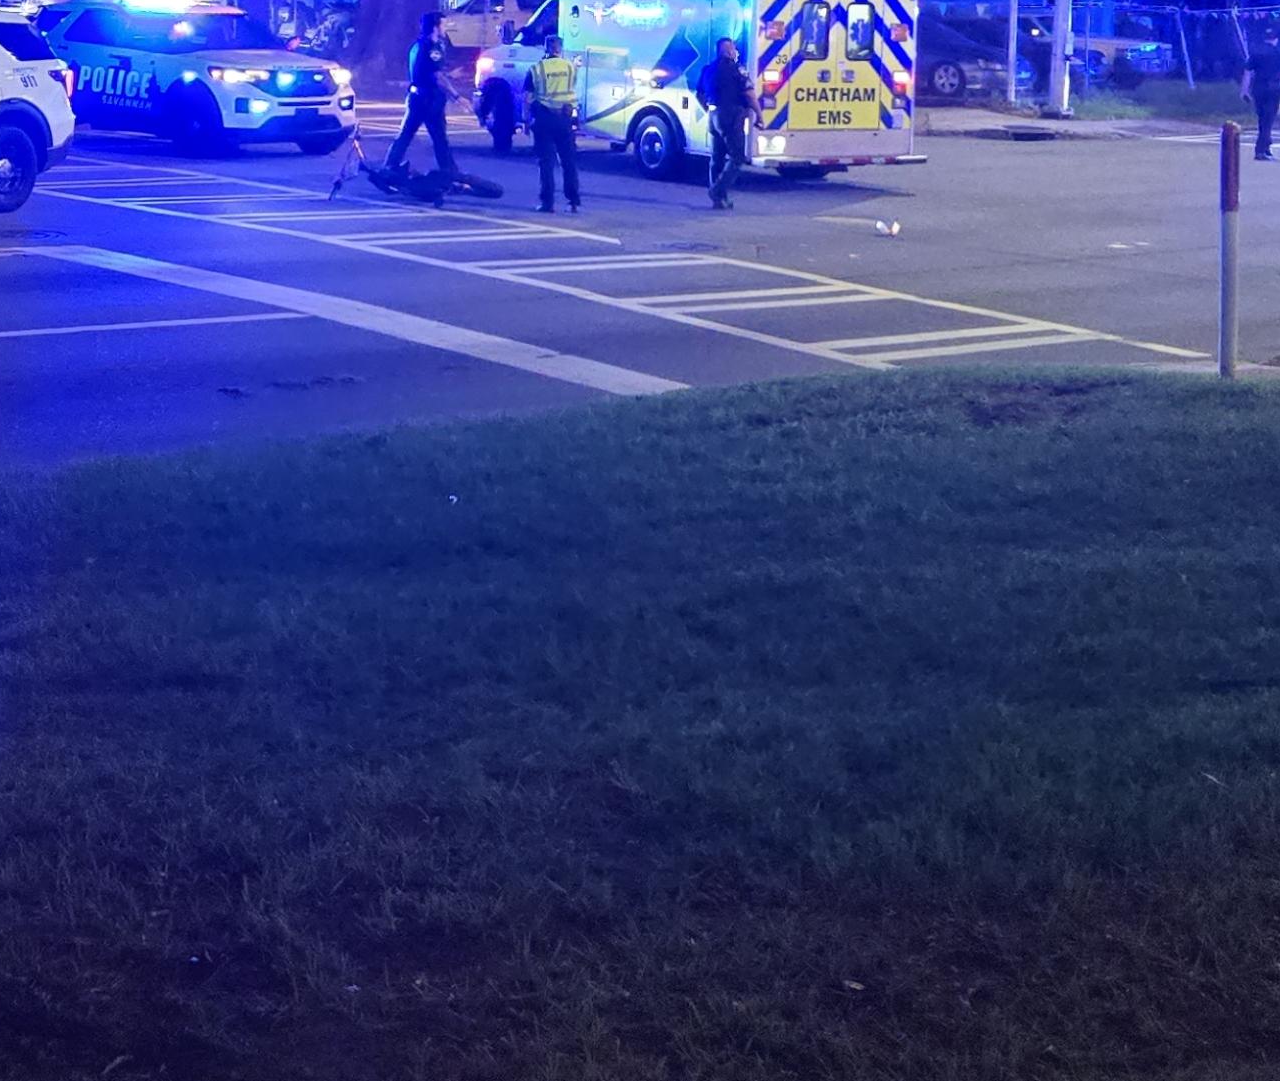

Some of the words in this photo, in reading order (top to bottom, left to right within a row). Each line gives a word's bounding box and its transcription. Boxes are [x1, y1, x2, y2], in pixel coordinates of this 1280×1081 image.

[20, 75, 38, 88] 911
[77, 65, 153, 99] POLICE
[794, 88, 876, 102] CHATHAM
[817, 110, 852, 125] EMS
